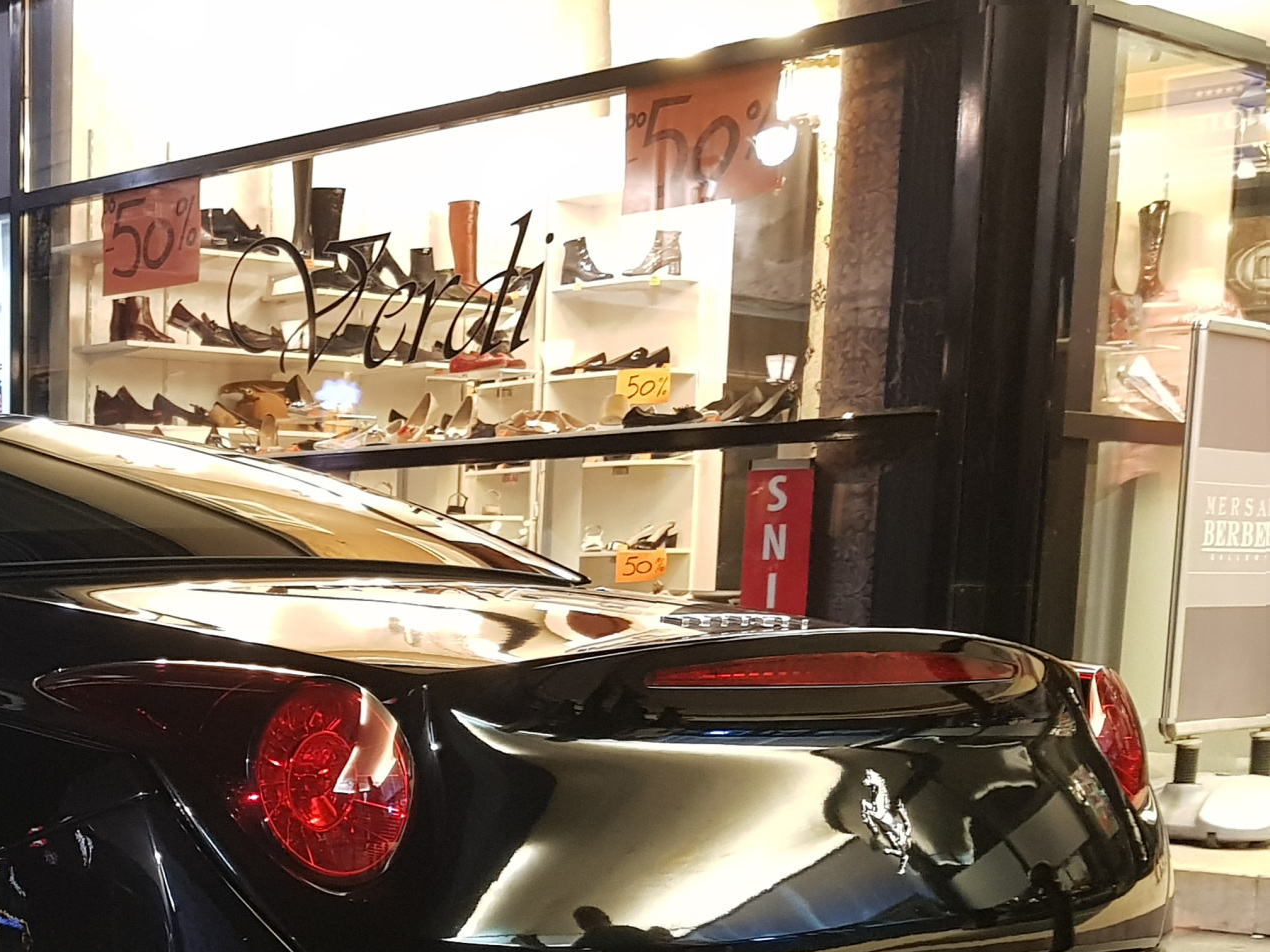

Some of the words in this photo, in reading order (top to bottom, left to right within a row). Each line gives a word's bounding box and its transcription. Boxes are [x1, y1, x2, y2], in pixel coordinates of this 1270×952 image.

[226, 209, 554, 374] Verdi
[627, 374, 668, 399] 50%
[622, 556, 665, 576] 50%
